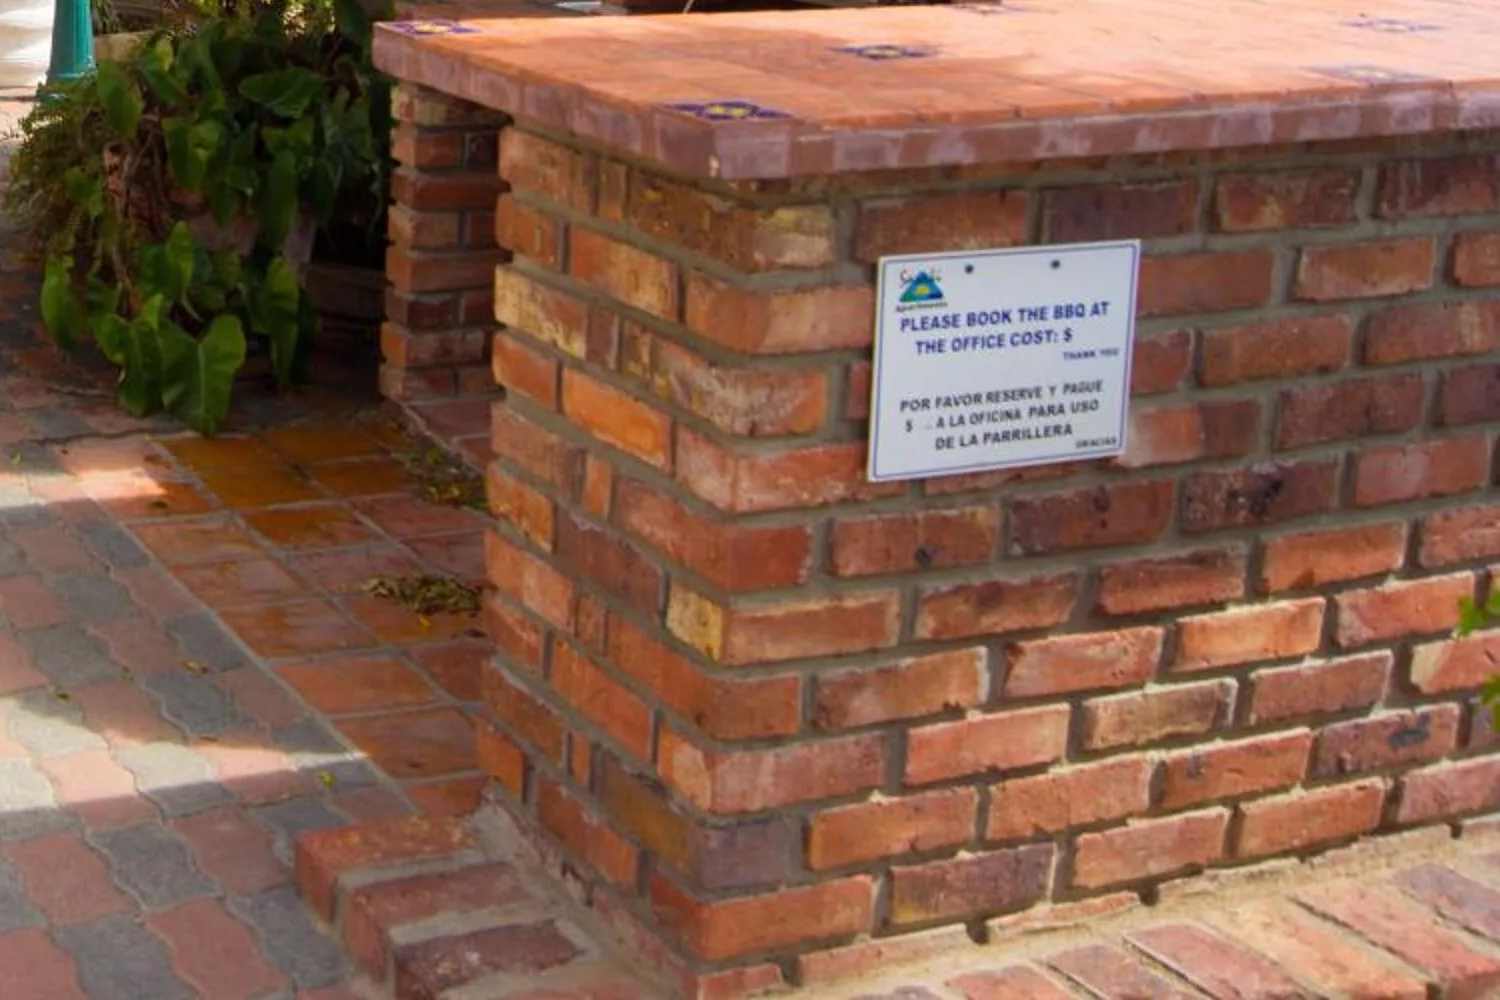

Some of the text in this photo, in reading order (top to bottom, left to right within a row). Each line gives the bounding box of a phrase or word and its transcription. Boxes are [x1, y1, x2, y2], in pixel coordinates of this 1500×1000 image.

[900, 302, 1110, 332] PLEASE BOOK THE BBQ AT
[916, 328, 1073, 356] THE OFFICE COST: $
[1063, 348, 1119, 361] THANK YOU
[900, 379, 1103, 412] POR FAVOR RESERVE Y PAGUE
[936, 416, 945, 428] A
[949, 414, 966, 428] LA
[969, 408, 1021, 425] OFICINA
[1028, 404, 1065, 419] PARA
[1070, 399, 1099, 413] USO
[935, 423, 1073, 450] DE LA PARRILLERA
